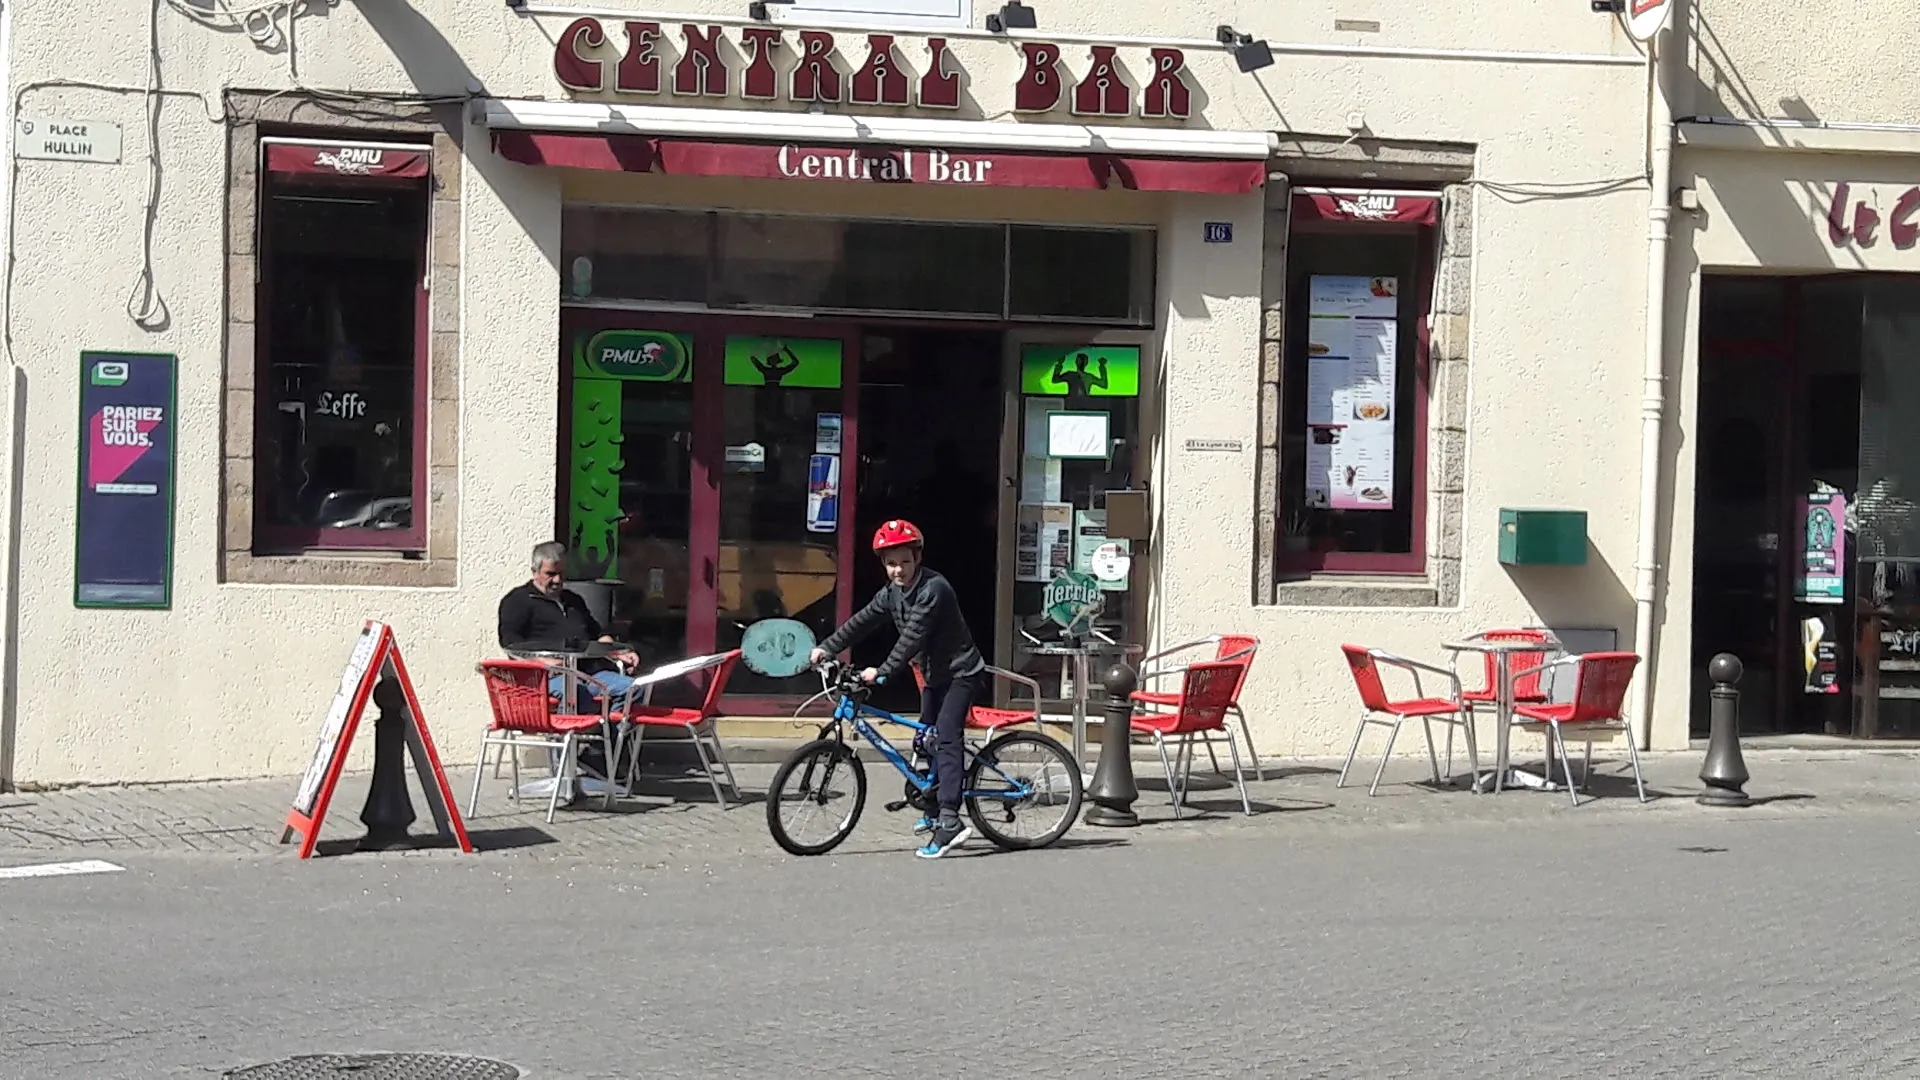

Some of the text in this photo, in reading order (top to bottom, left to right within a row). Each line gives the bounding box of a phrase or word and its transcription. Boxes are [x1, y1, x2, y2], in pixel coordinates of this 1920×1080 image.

[554, 16, 1192, 119] CENTRAL BAR
[49, 124, 88, 136] PLACE
[44, 140, 93, 155] HULLIN
[340, 148, 383, 164] PMU
[777, 142, 993, 183] Central Bar
[1210, 225, 1226, 240] 16
[601, 348, 643, 364] PMU
[103, 405, 163, 421] PARIEZ
[315, 391, 367, 419] Leffe
[102, 419, 137, 433] SUR
[103, 432, 154, 447] VOUS.
